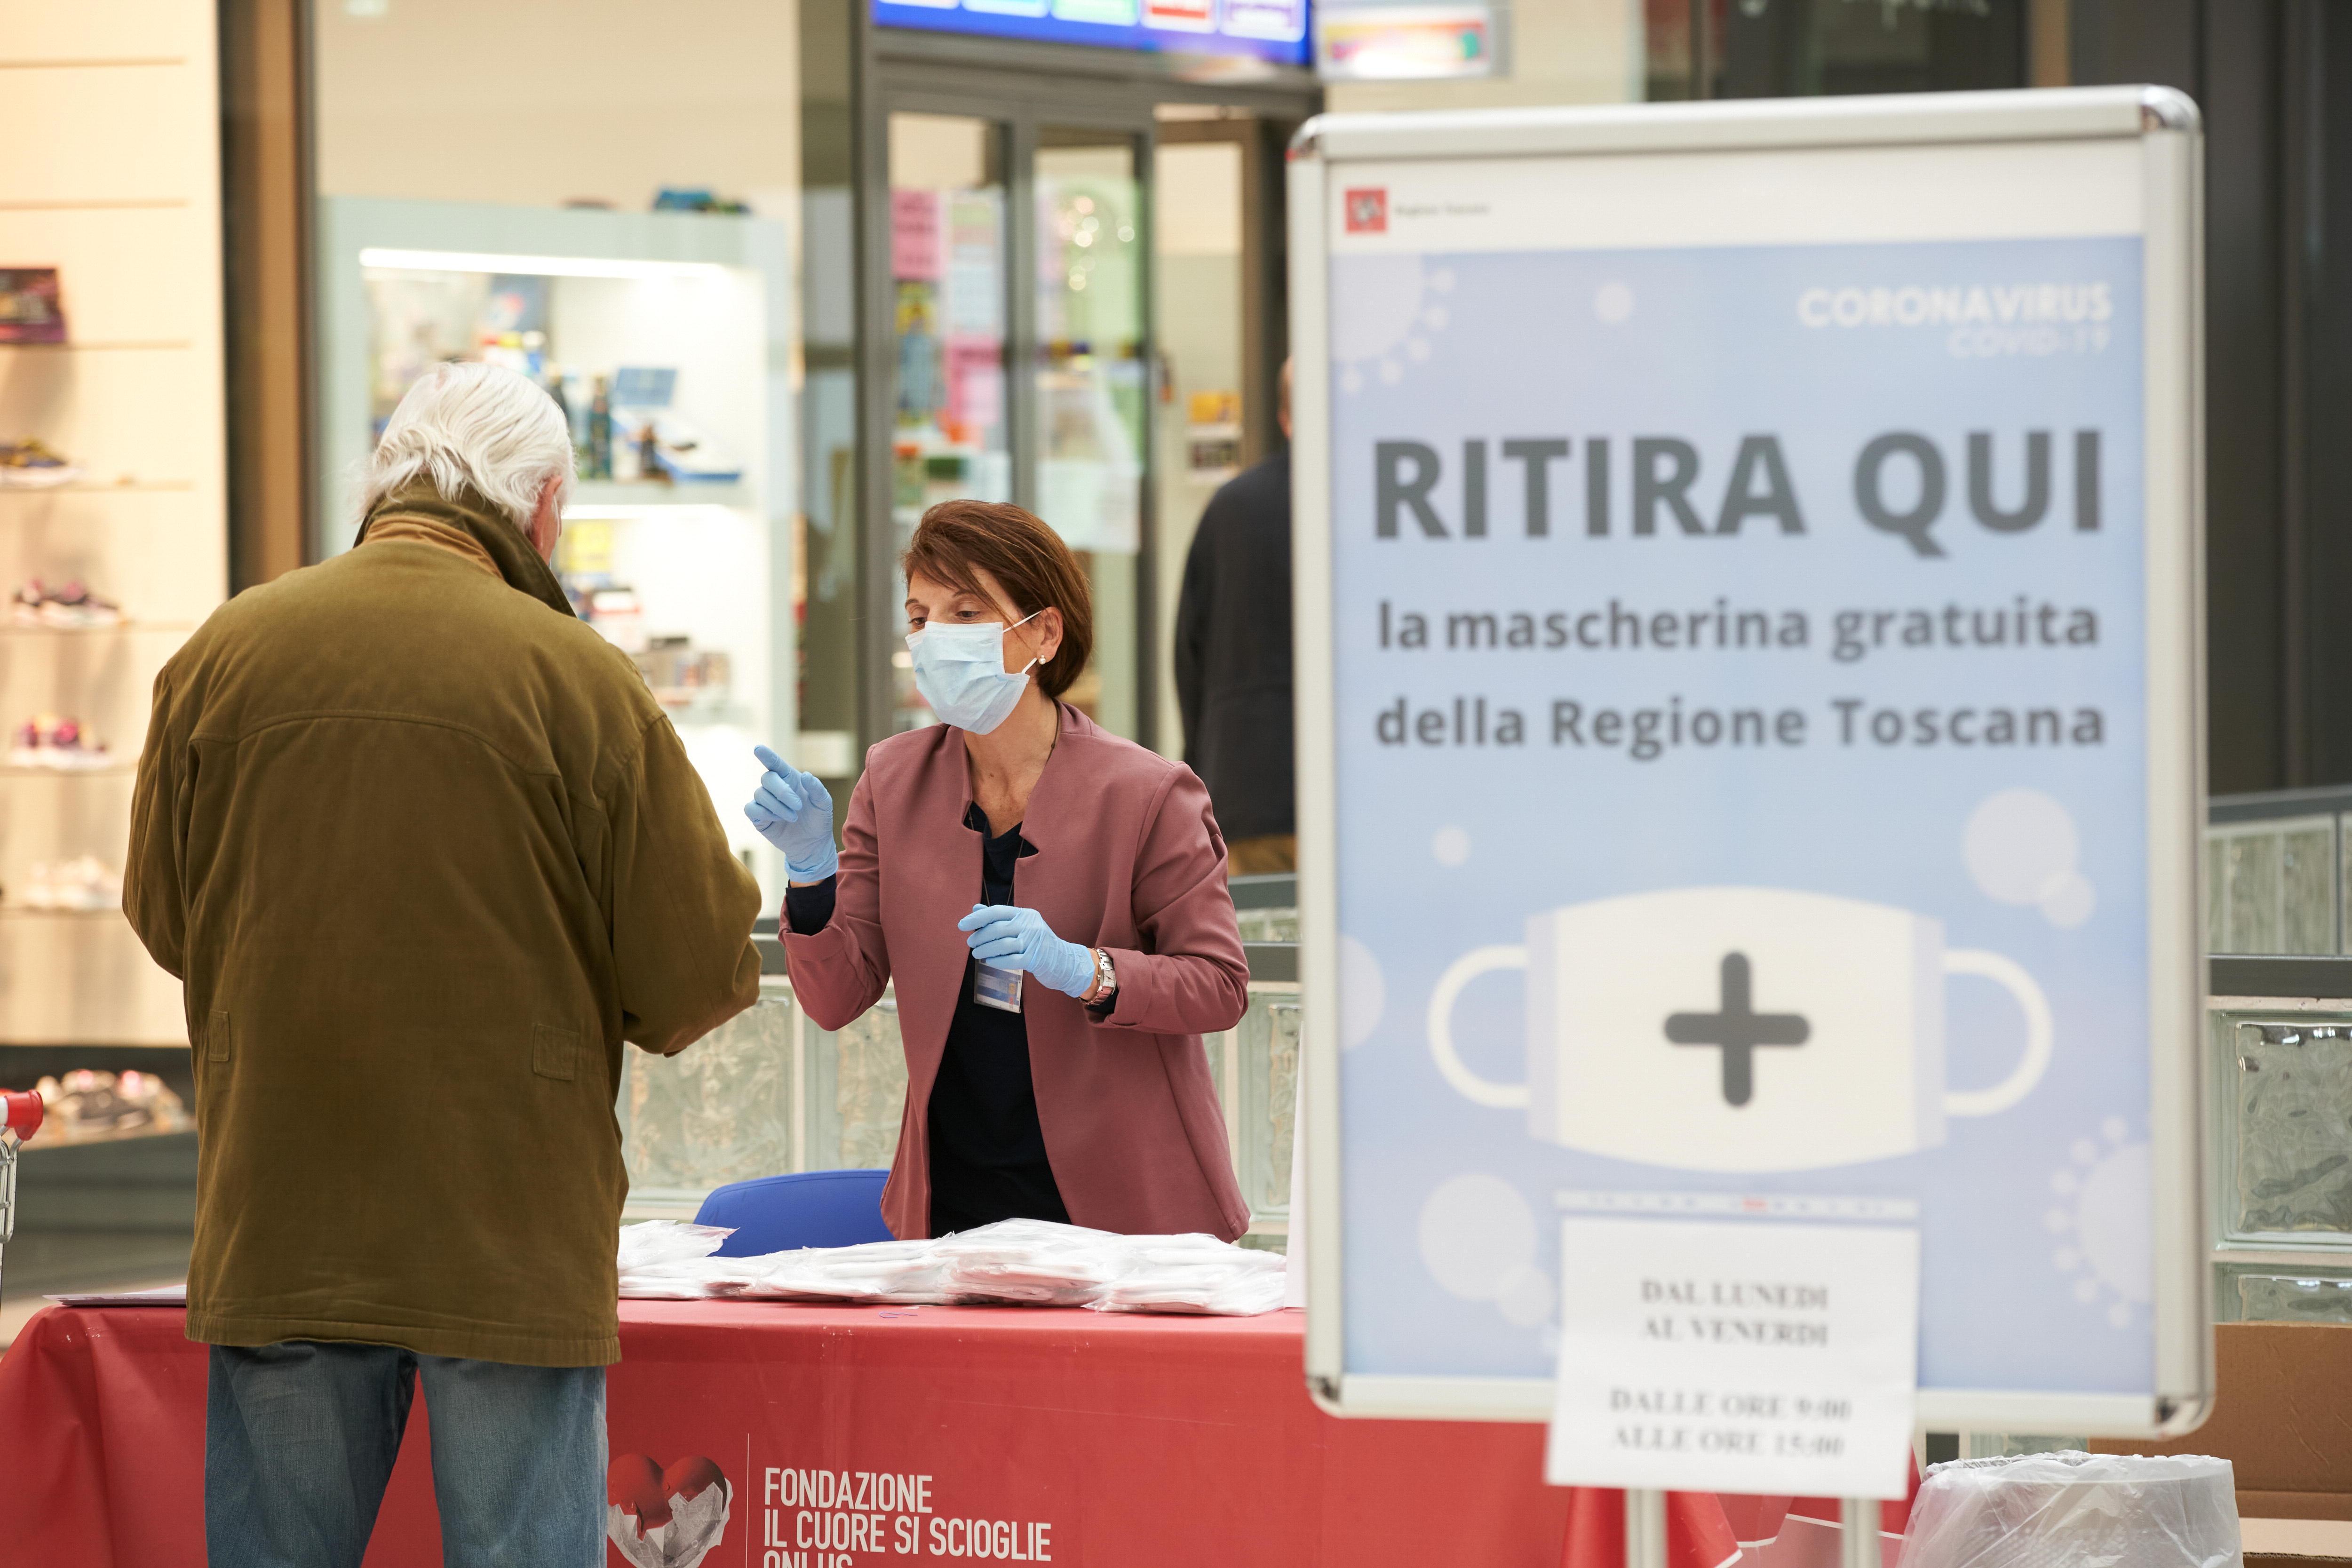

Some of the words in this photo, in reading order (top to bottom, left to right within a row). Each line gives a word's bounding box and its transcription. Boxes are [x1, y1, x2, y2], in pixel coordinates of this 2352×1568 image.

[1797, 282, 2113, 327] CORONAVIRUS
[1373, 433, 1808, 539] RITIRA
[1852, 429, 2103, 559] QUI
[1378, 601, 1429, 649] la
[1446, 598, 1810, 649] mascherina
[1831, 595, 2100, 662] gratuita
[1375, 698, 1526, 747] della
[1551, 696, 1807, 761] Regione
[1831, 698, 2105, 747] Toscana
[1640, 1279, 1706, 1306] DAL
[1640, 1316, 1684, 1341] AL
[1609, 1389, 1708, 1416] DALLE
[1720, 1393, 1789, 1420] ORE
[1610, 1428, 1694, 1453] ALLE
[1699, 1430, 1767, 1455] ORE
[764, 1467, 932, 1513] FONDAZIONE
[764, 1509, 787, 1547] IL
[796, 1511, 886, 1552] CUORE
[894, 1515, 919, 1554] SI
[929, 1517, 1051, 1561] SCIOGLIE
